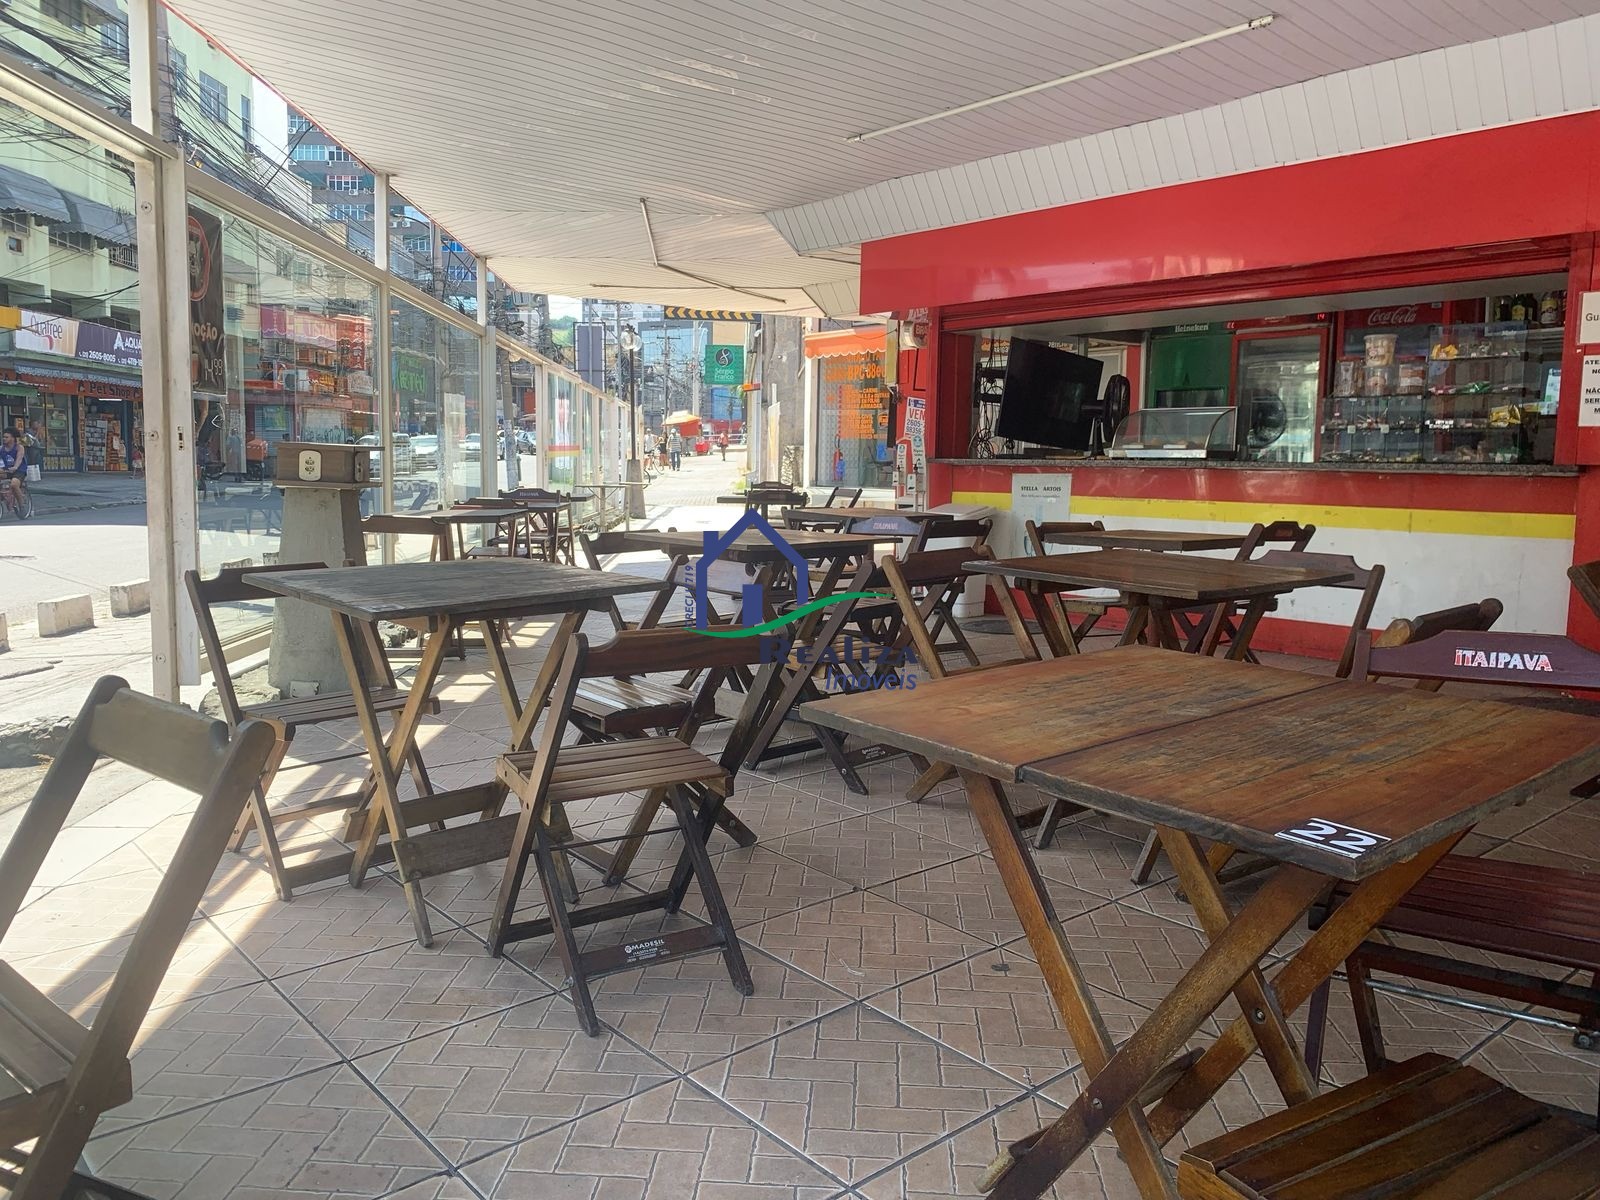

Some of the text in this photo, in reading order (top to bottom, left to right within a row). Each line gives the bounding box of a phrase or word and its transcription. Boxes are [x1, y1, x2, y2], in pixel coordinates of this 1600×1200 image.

[193, 322, 218, 341] OÇÃO
[1175, 322, 1209, 333] Heineken
[1454, 649, 1553, 672] ITAIPAVA
[1290, 822, 1377, 852] 22
